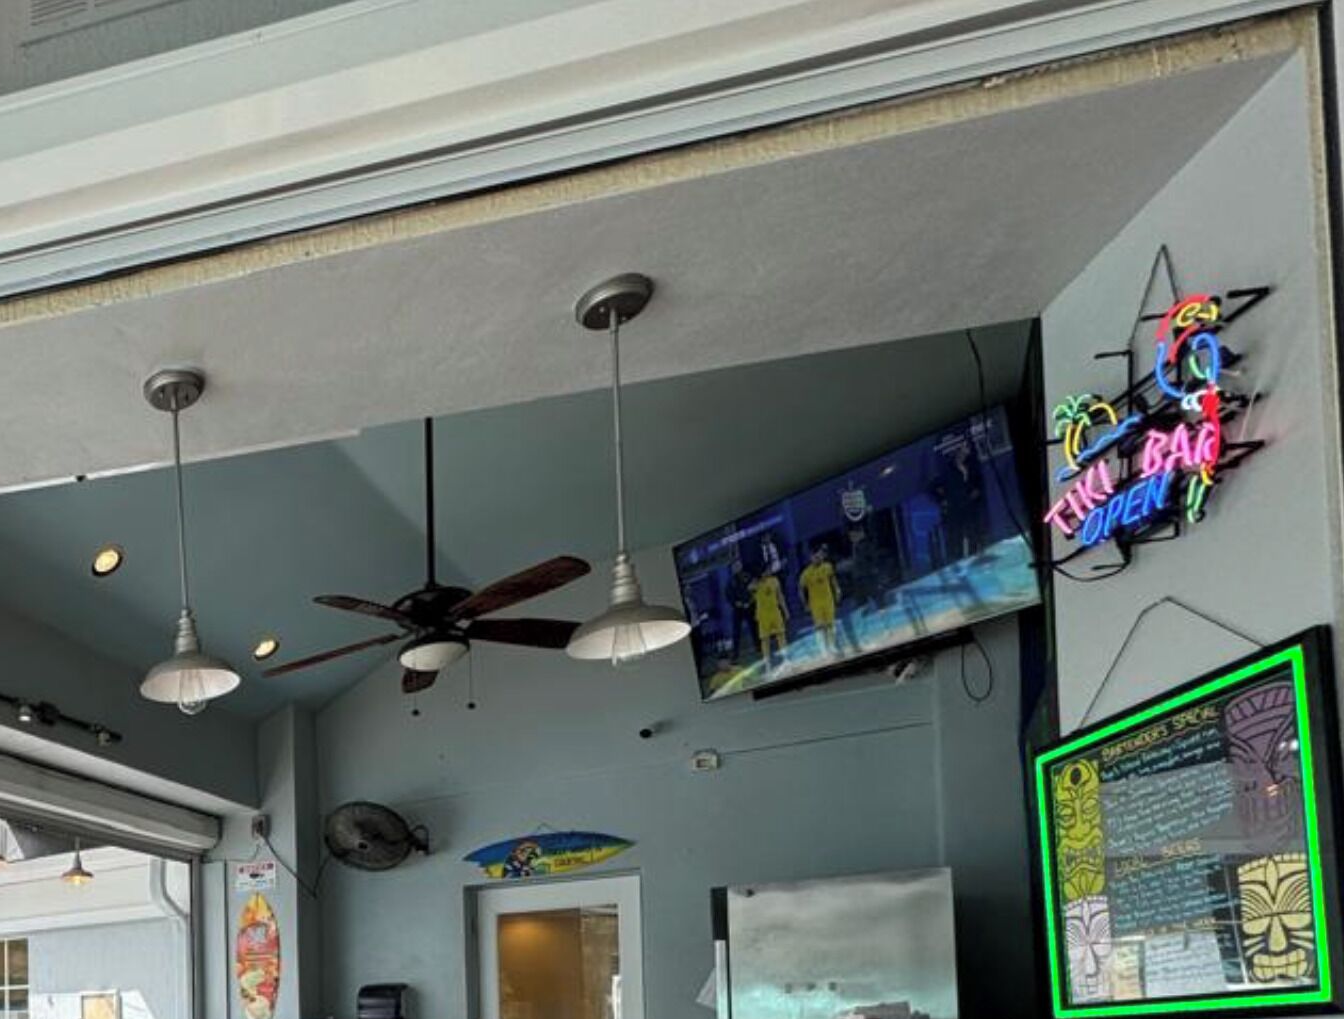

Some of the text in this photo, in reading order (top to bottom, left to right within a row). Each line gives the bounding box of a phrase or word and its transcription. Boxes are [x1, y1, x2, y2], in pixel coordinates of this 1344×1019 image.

[1044, 422, 1219, 536] TIKI BAR
[1080, 471, 1173, 546] OPEN
